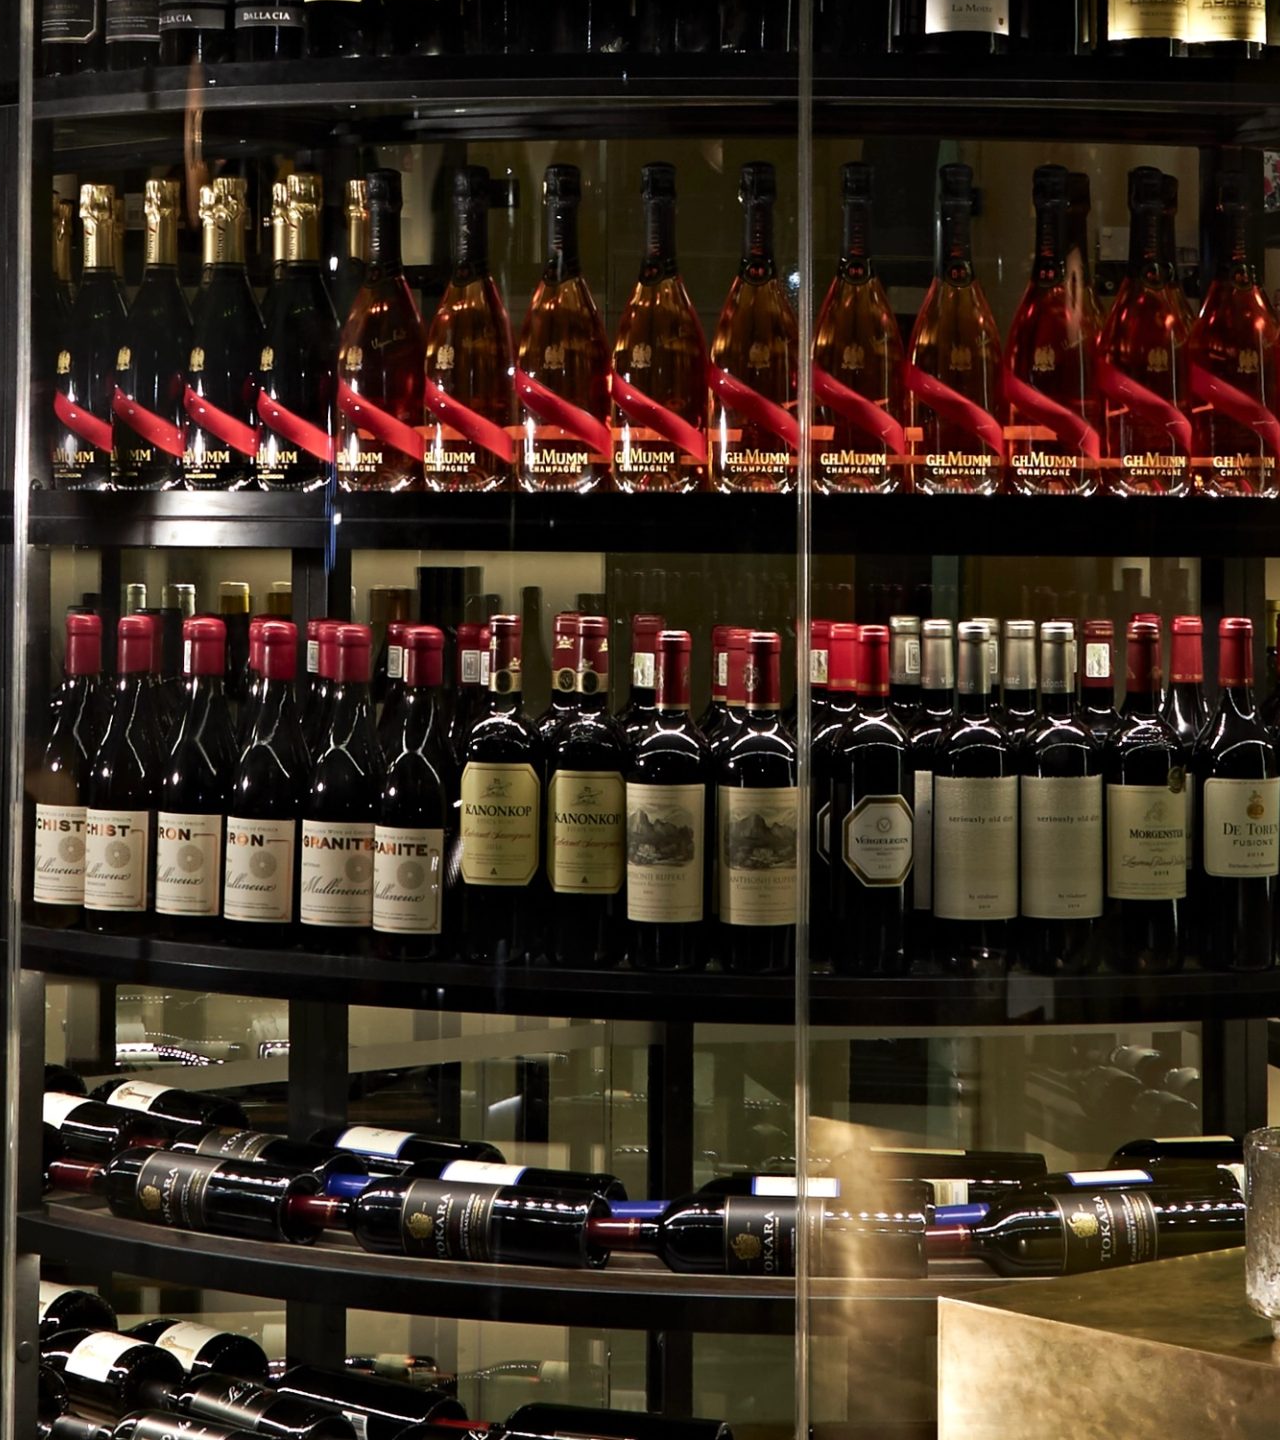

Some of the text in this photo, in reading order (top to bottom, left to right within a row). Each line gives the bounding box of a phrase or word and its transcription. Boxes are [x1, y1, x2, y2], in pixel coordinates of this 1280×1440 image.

[952, 4, 963, 13] La
[730, 464, 785, 473] CHAMPAGNE
[826, 465, 880, 474] CHAMPAGNE
[932, 467, 986, 476] CHAMPAGNE
[1017, 468, 1071, 476] CHAMPAGNE
[1130, 468, 1182, 477] CHAMPAGNE
[466, 804, 532, 816] KANONKOP
[949, 816, 985, 824] seriously
[1037, 815, 1074, 823] seriously
[1223, 823, 1242, 836] DE
[1092, 1195, 1112, 1262] TOKARA
